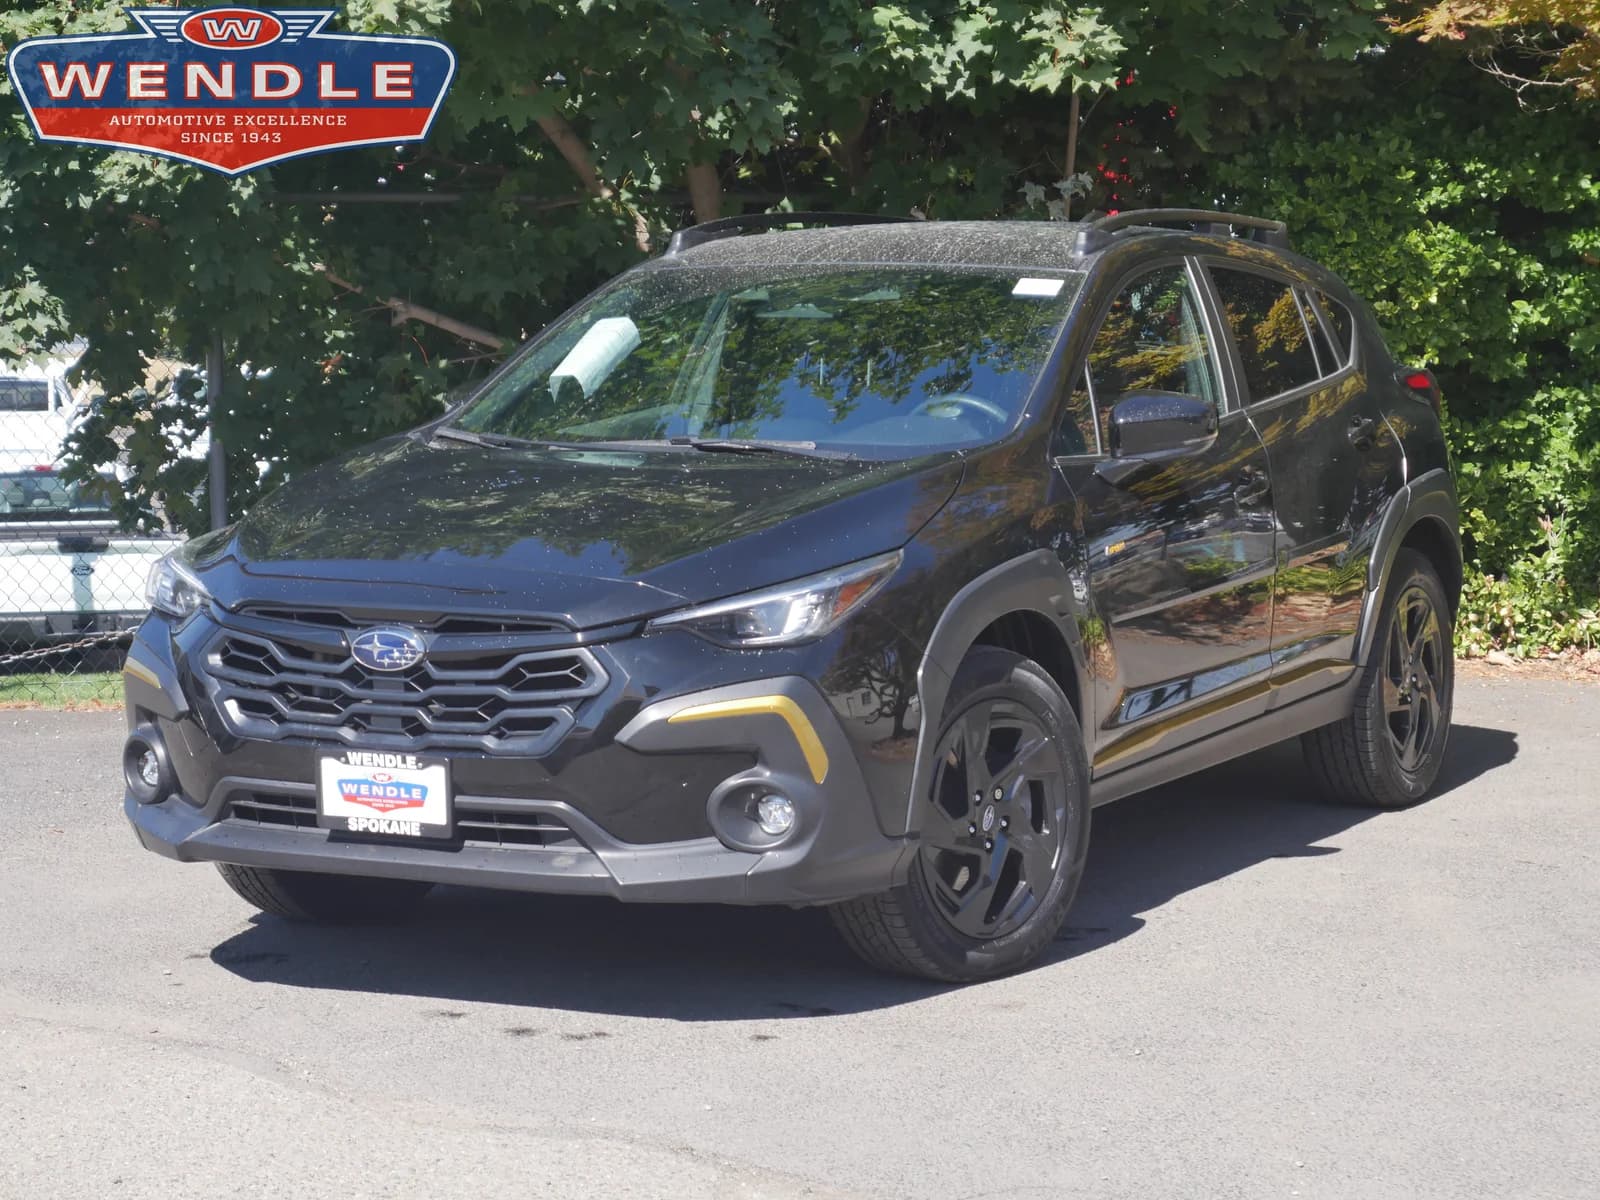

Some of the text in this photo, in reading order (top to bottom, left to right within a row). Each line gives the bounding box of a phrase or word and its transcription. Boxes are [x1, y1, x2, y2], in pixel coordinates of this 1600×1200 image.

[347, 752, 417, 770] WENDLE
[342, 783, 422, 799] WENDLE
[348, 817, 421, 836] SPOKANE
